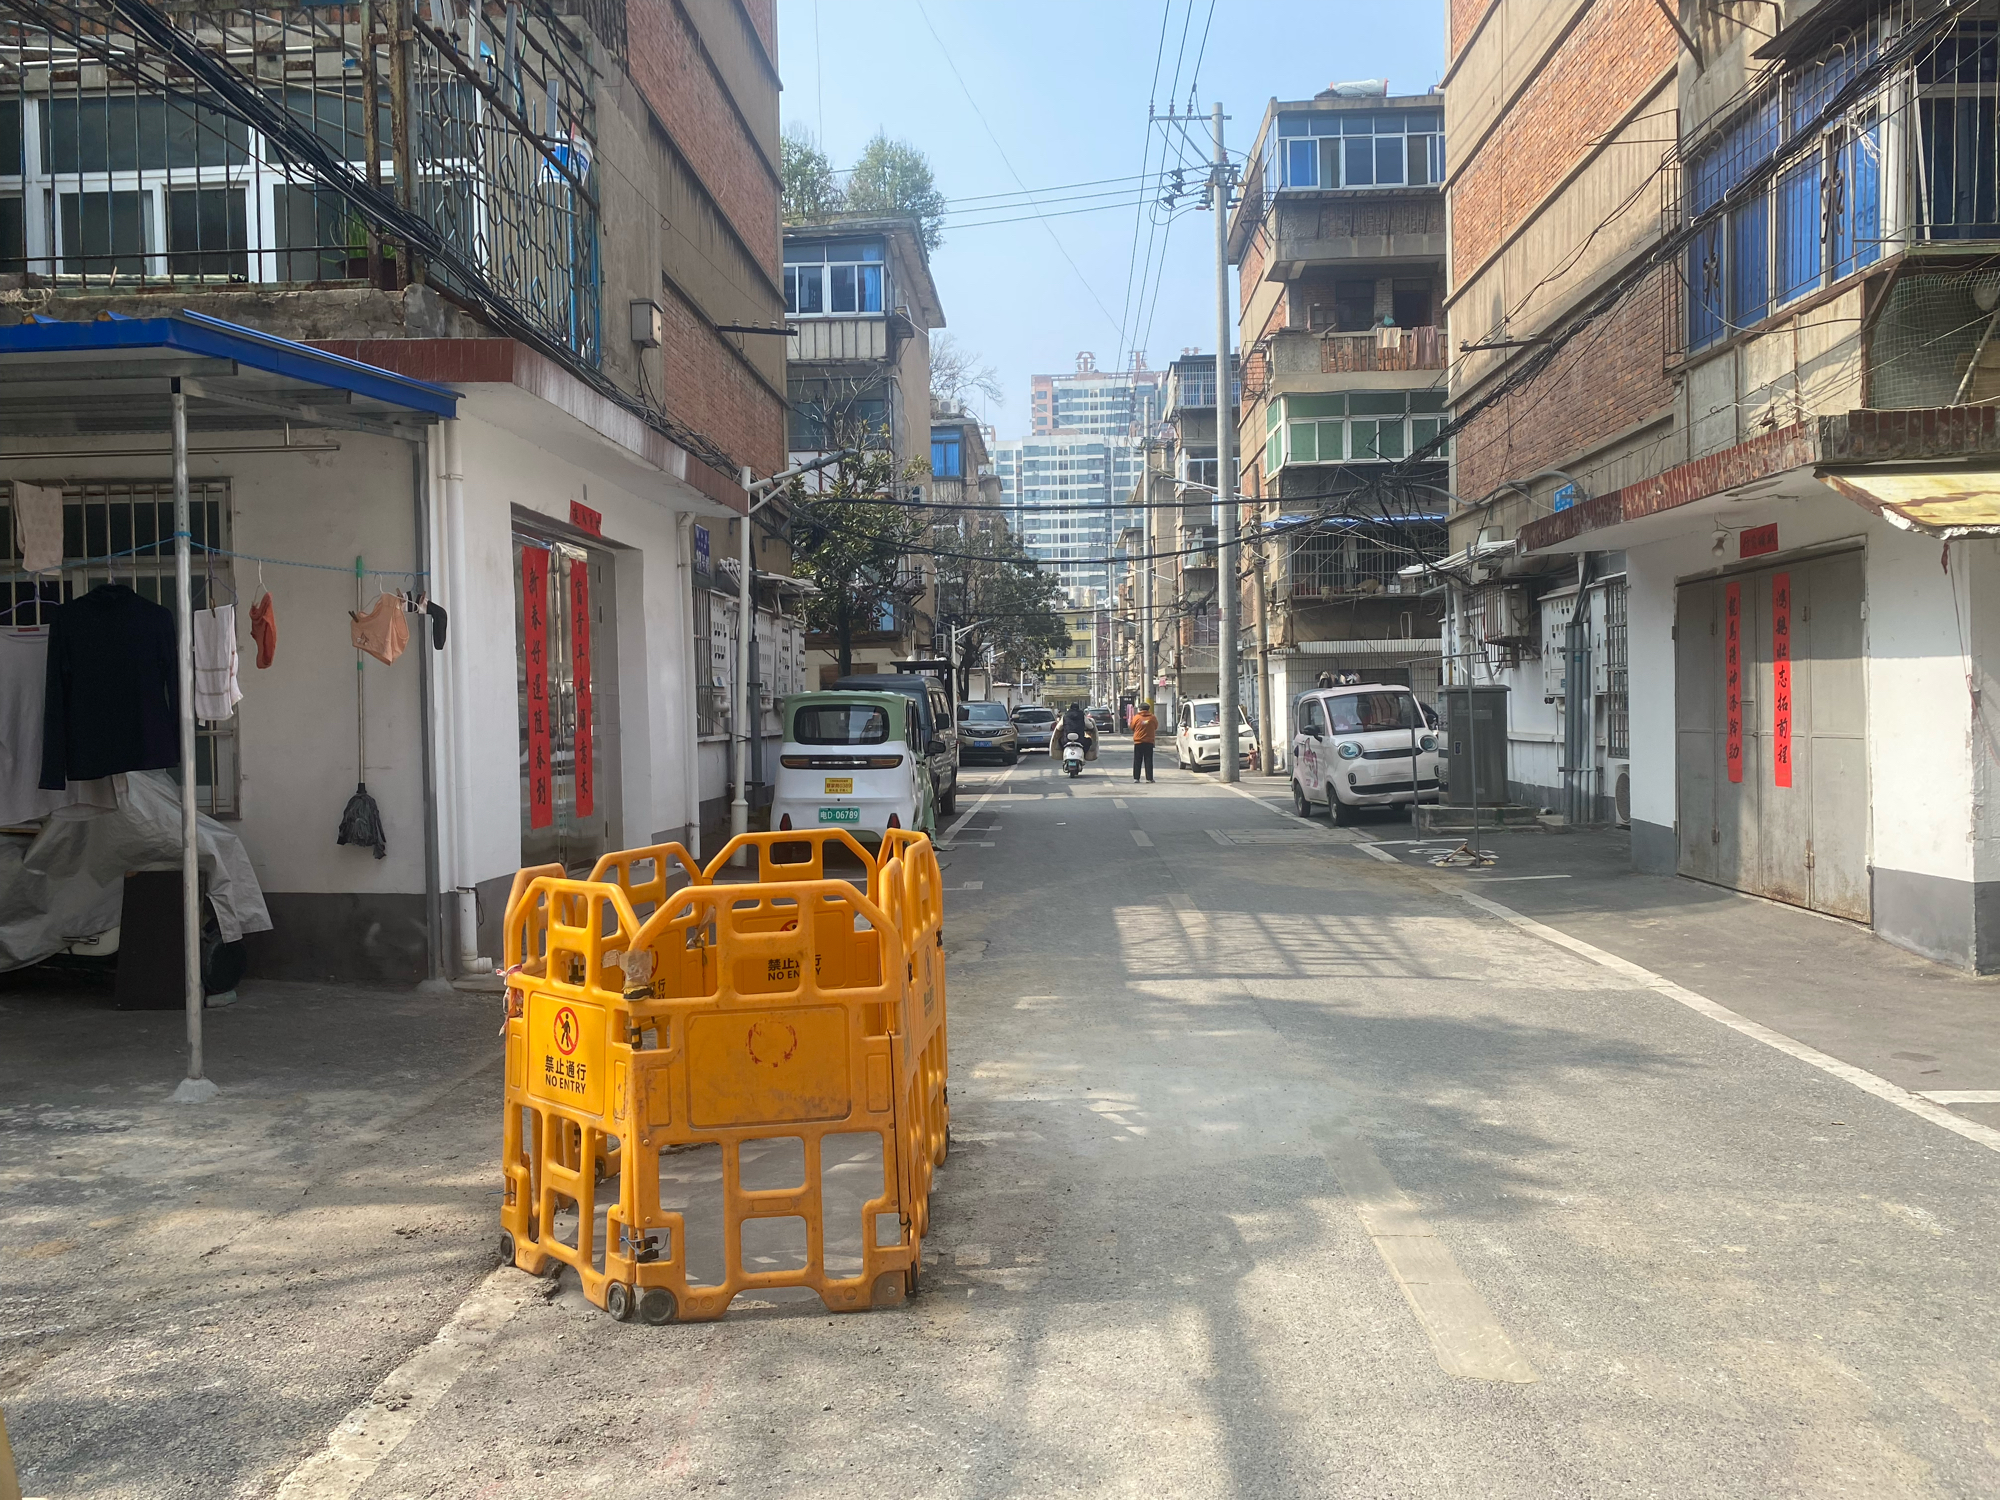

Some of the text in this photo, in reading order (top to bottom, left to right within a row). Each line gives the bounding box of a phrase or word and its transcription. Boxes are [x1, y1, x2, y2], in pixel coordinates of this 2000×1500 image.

[768, 967, 821, 981] NO ENY
[545, 1055, 587, 1081] 禁止通行
[545, 1074, 587, 1095] NO ENTRY
